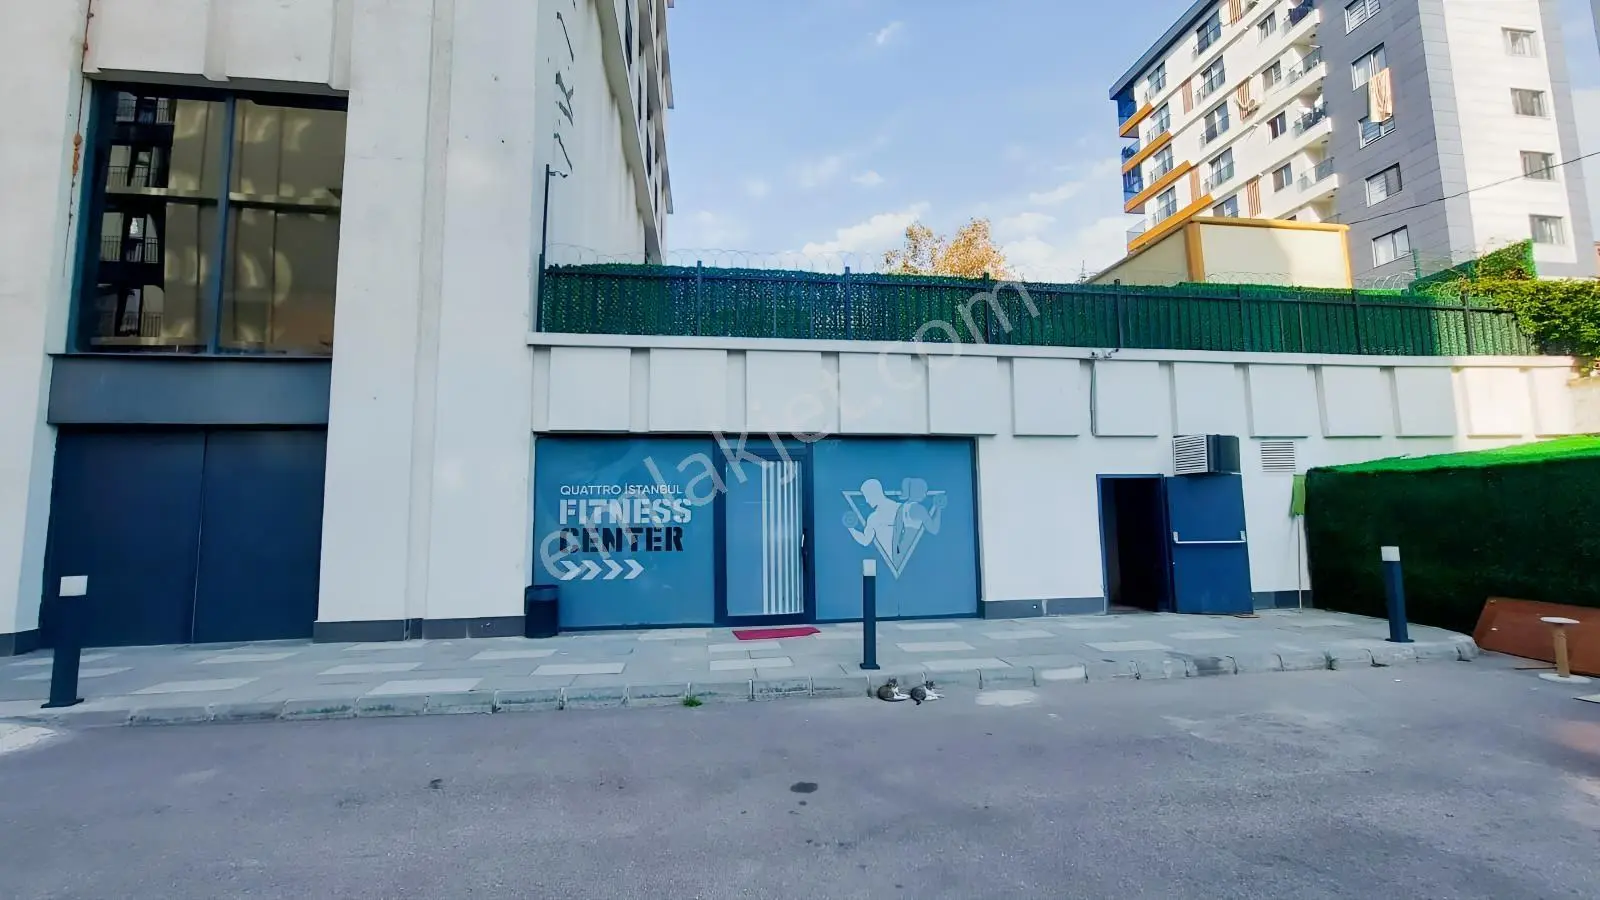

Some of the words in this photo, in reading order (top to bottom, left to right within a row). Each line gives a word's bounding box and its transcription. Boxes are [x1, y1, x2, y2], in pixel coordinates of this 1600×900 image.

[560, 485, 622, 496] QUATTRO
[559, 498, 692, 524] FITNESS
[559, 526, 684, 552] CENTER
